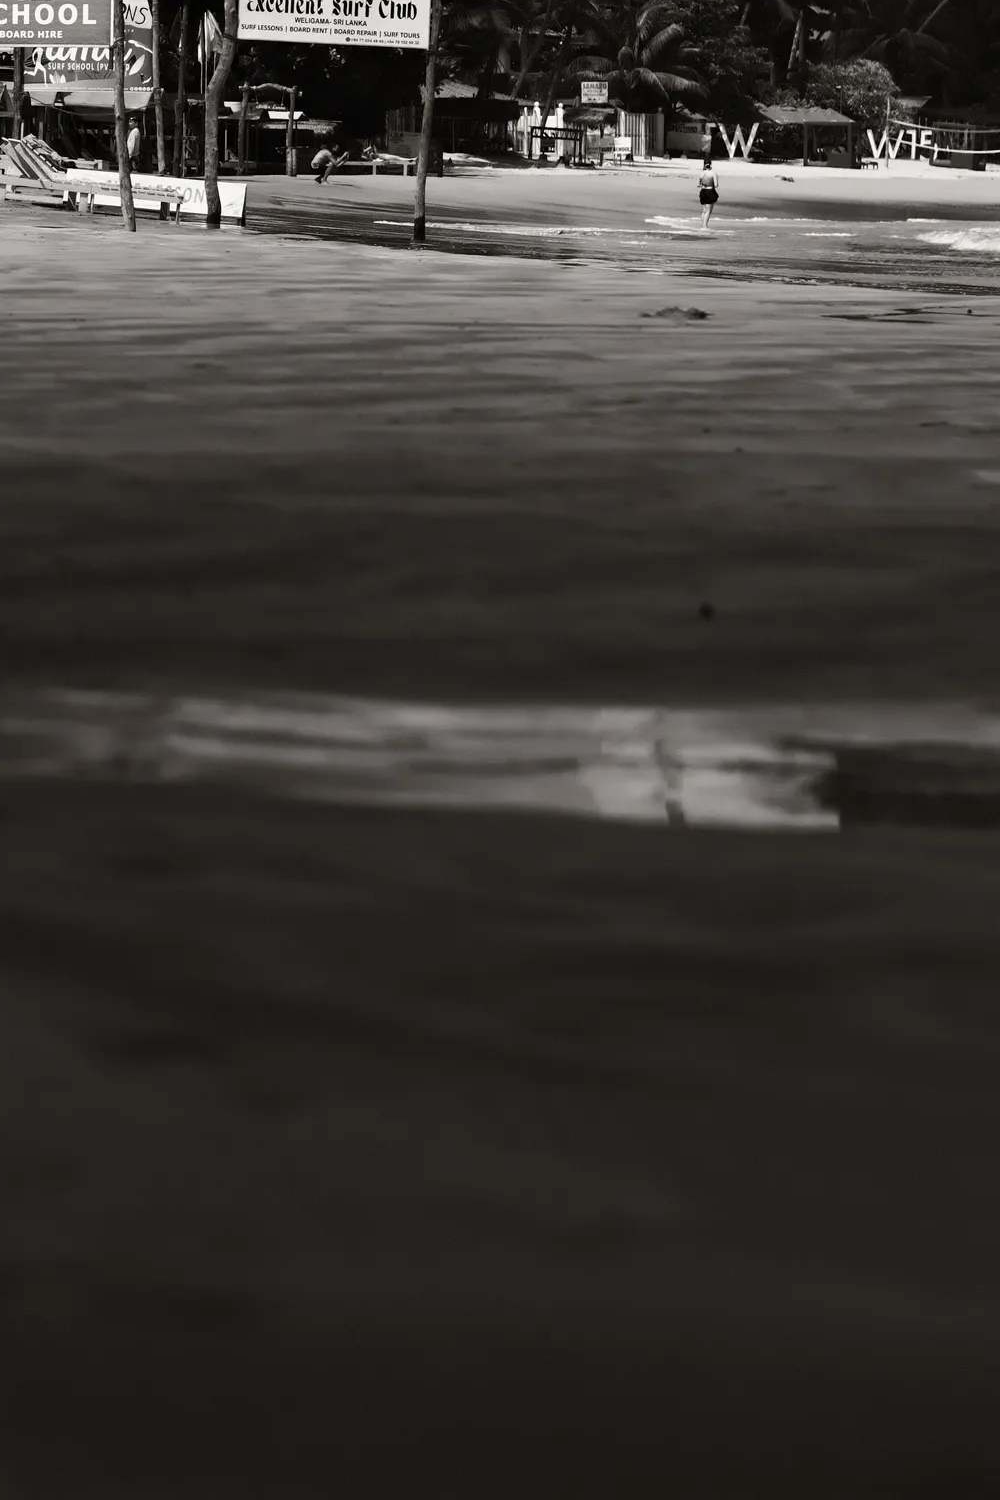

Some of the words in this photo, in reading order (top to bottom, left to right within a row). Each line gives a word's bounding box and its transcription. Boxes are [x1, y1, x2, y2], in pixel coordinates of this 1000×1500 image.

[345, 19, 368, 27] LANKA
[0, 30, 35, 38] BOARD
[38, 30, 63, 38] HIRE
[334, 28, 356, 36] BOARD
[357, 29, 378, 37] REPAIR
[47, 62, 66, 70] SURF
[67, 62, 95, 71] SCHOOL
